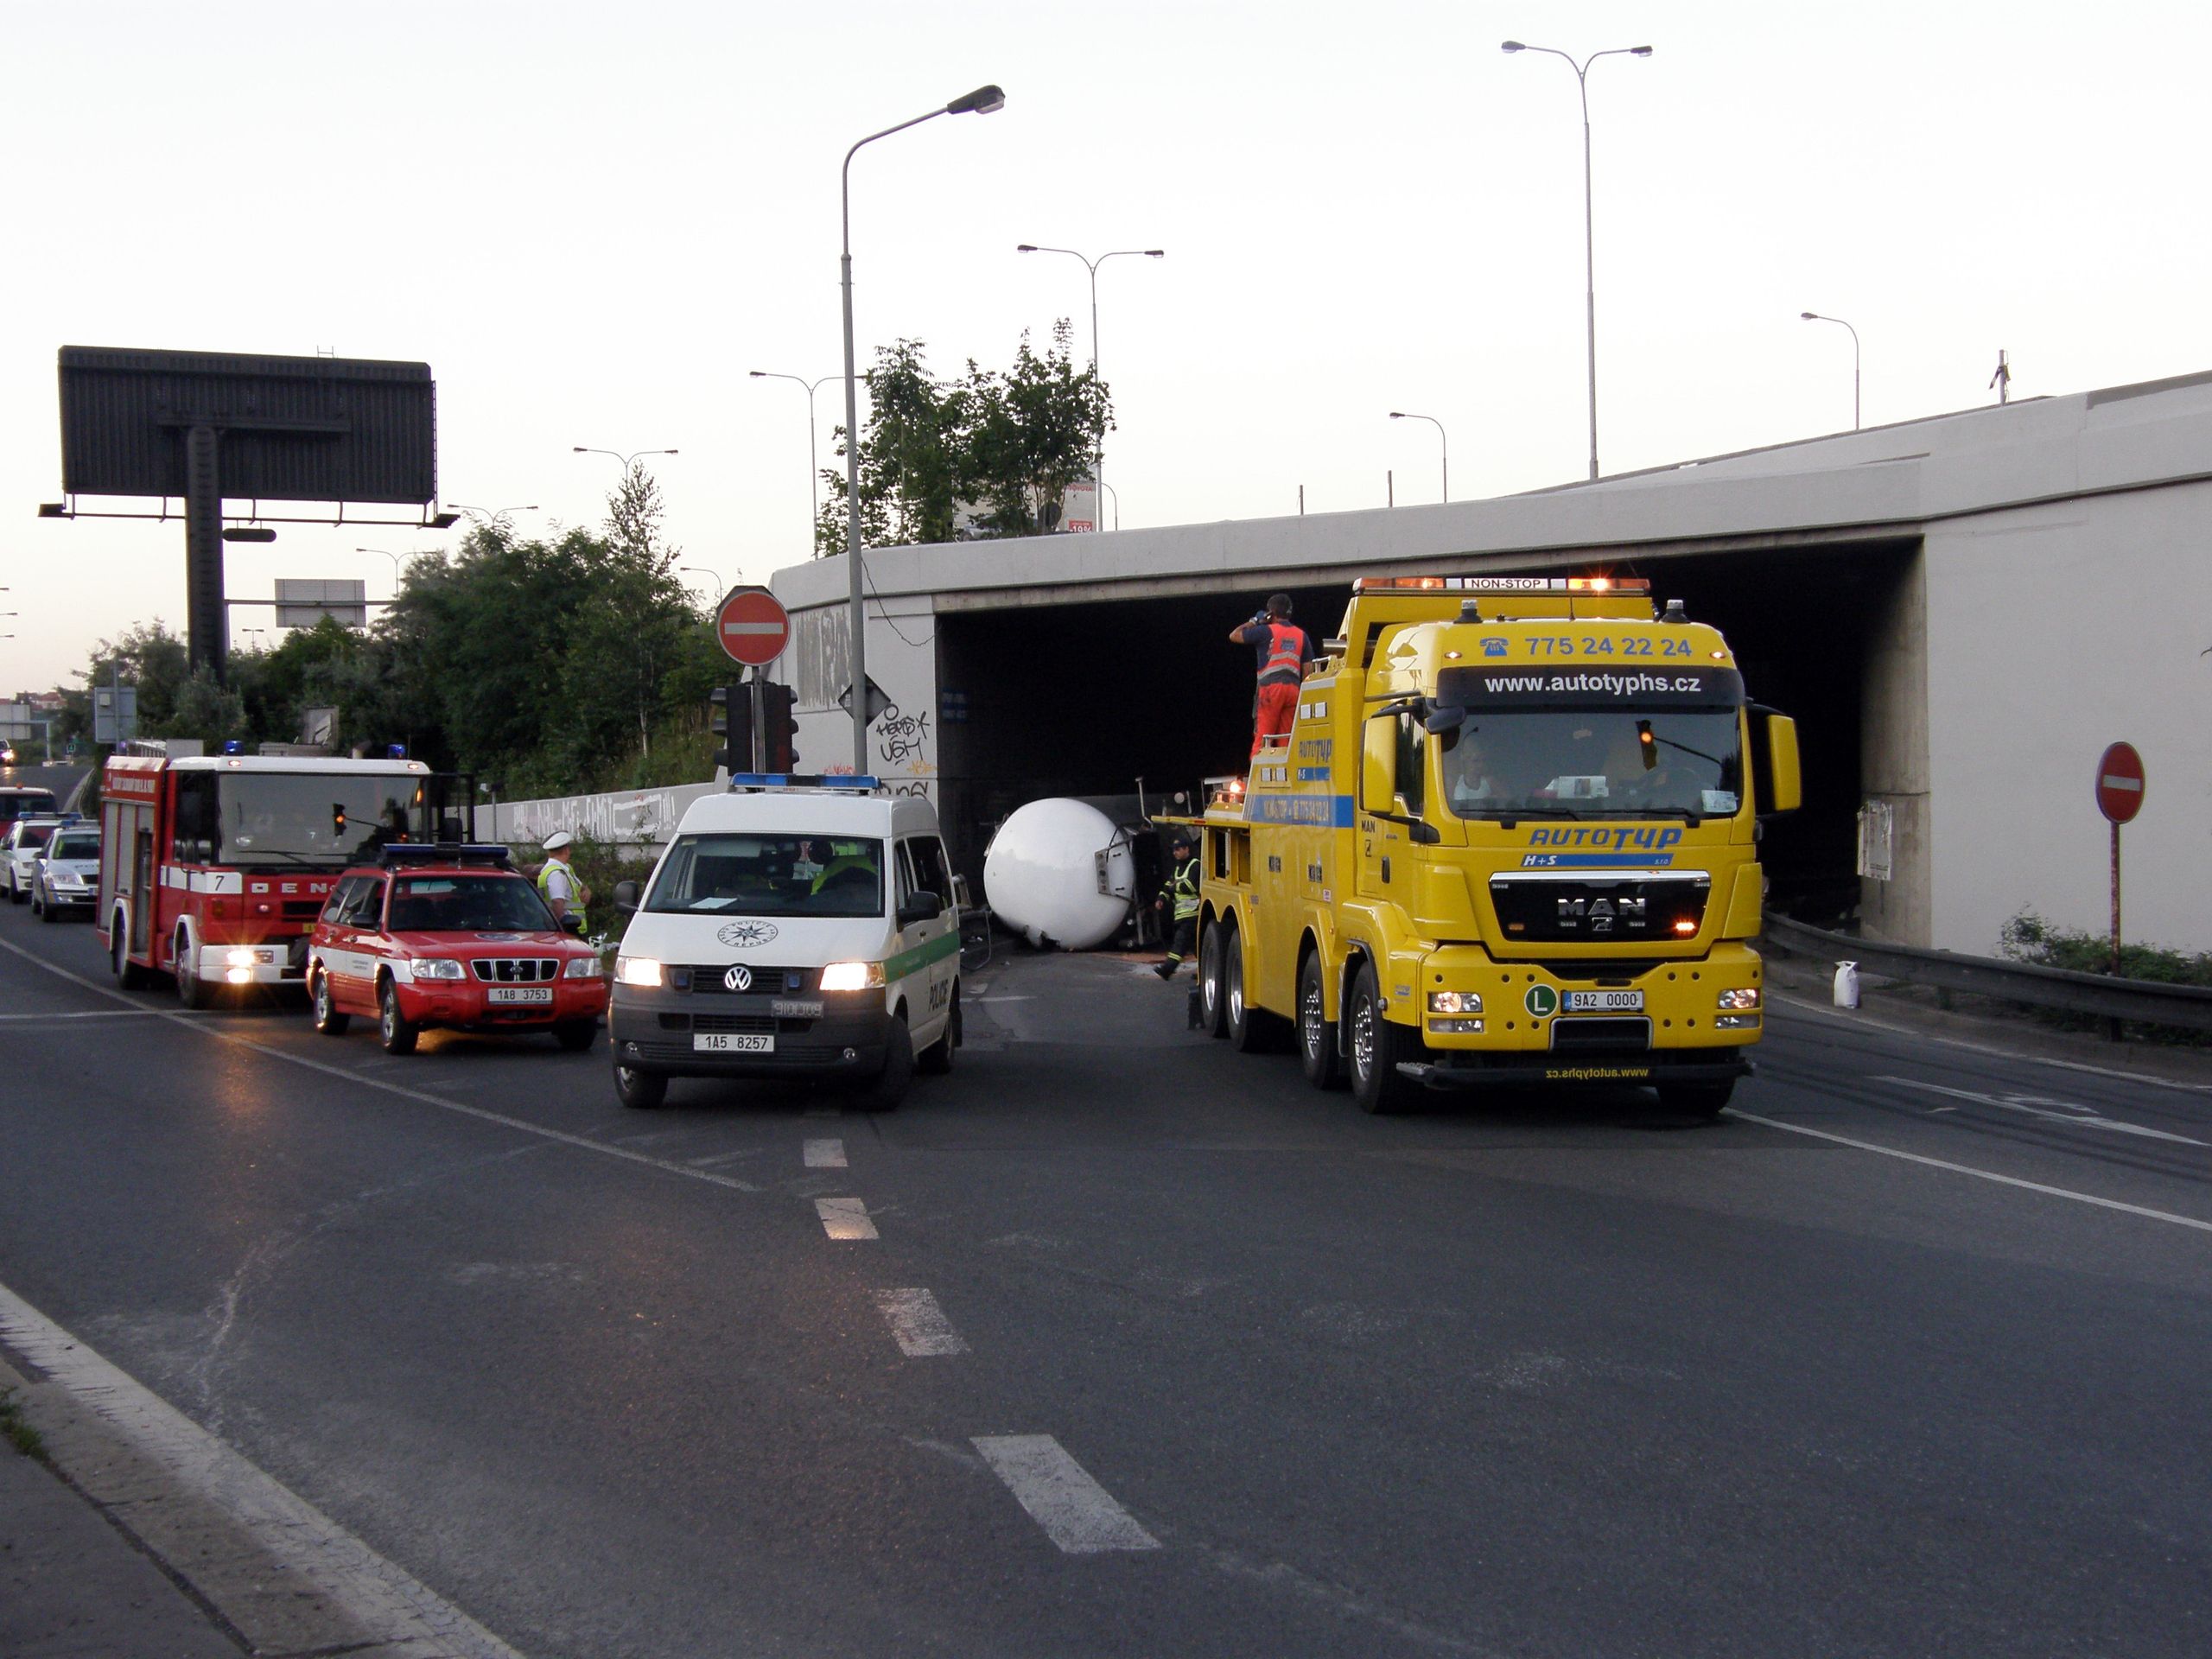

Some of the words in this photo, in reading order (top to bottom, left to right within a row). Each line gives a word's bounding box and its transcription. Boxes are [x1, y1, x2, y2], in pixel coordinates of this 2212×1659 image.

[1471, 579, 1541, 588] NON-STOP
[1525, 638, 1573, 655] 775
[1581, 638, 1613, 655] 24
[1621, 638, 1653, 656] 22
[1661, 639, 1692, 657] 24
[1484, 673, 1701, 696] www.autotyphs.cz
[1529, 828, 1683, 851] AUTOTYP
[1523, 855, 1557, 866] H+S
[214, 875, 225, 891] 7
[251, 883, 327, 893] DEN
[1558, 898, 1646, 916] MAN
[497, 990, 515, 1000] 1A8
[523, 989, 548, 1000] 3753
[1534, 990, 1548, 1012] L
[1574, 994, 1597, 1007] 9A2
[1606, 994, 1637, 1006] 0000
[705, 1036, 728, 1049] 1A5
[737, 1037, 768, 1050] 8257
